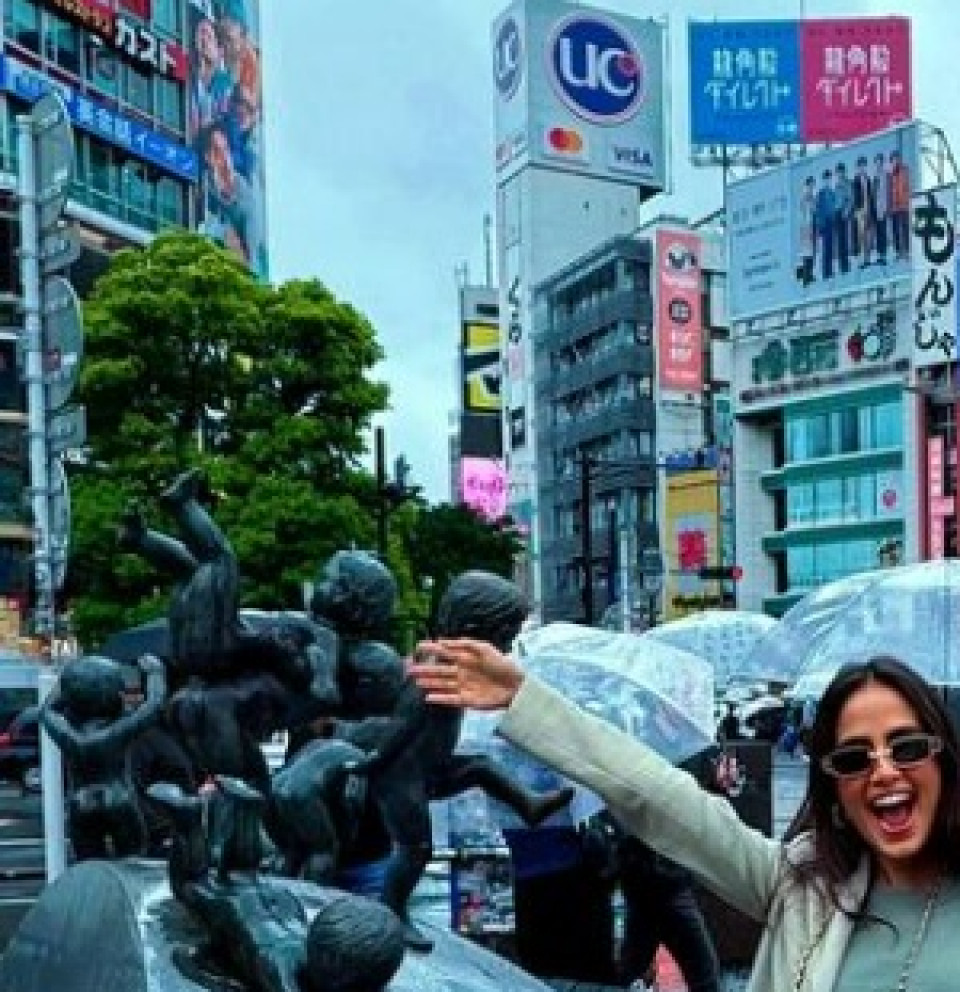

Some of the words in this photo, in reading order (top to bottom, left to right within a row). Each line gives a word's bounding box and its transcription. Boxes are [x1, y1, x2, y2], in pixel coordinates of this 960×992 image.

[560, 38, 637, 97] UC
[613, 146, 653, 166] VISA
[913, 190, 957, 357] もんじゃ
